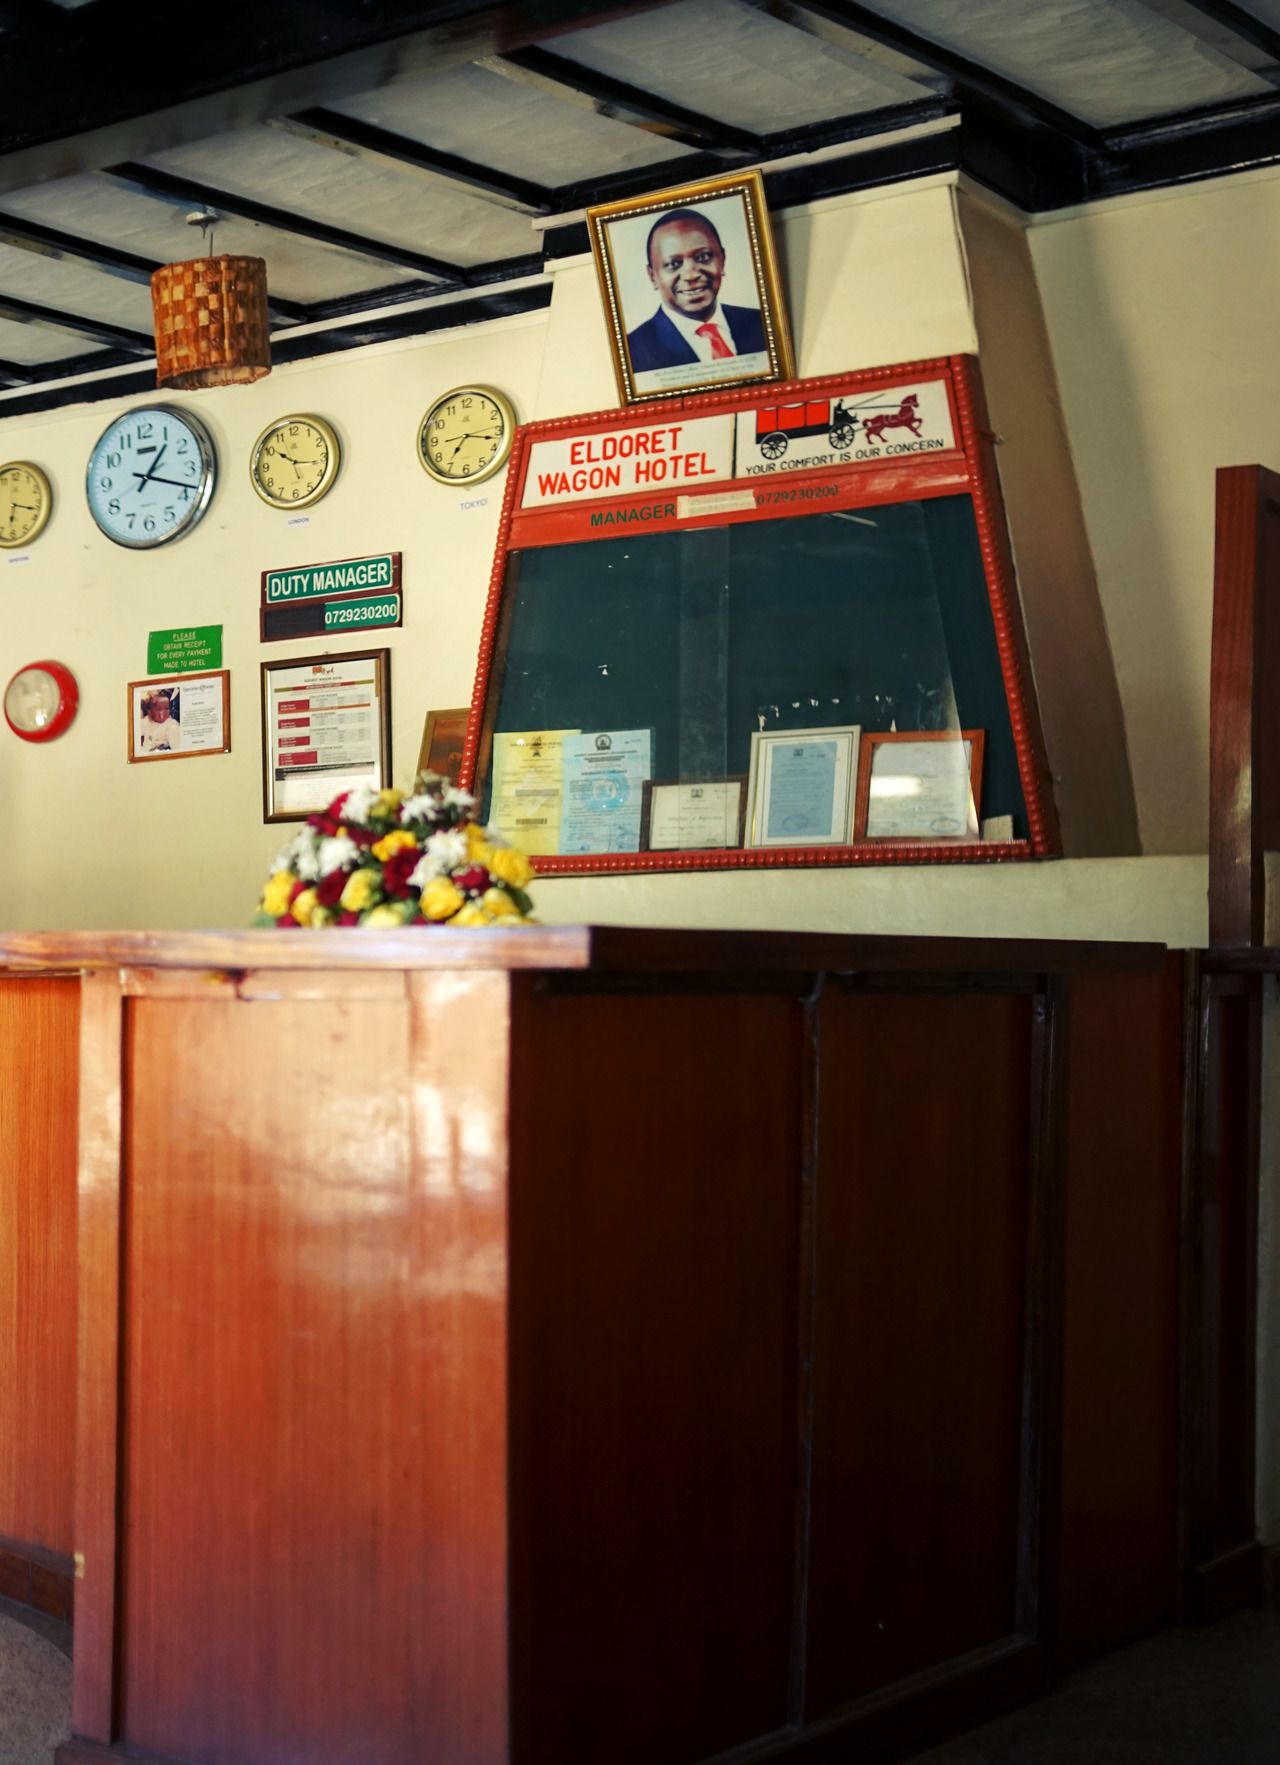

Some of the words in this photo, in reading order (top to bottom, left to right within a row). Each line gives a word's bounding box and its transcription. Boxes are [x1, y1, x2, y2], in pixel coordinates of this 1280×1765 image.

[461, 397, 473, 408] 12
[481, 400, 485, 410] 1
[446, 406, 456, 416] 11
[490, 409, 498, 420] 2
[435, 419, 445, 430] 10
[137, 423, 153, 440] 12
[163, 426, 168, 441] 1
[289, 426, 299, 437] 12
[307, 428, 311, 437] 1
[494, 425, 503, 436] 3
[120, 434, 131, 450] 11
[276, 433, 284, 443] 11
[316, 437, 323, 448] 2
[431, 437, 438, 447] 9
[176, 438, 187, 454] 2
[264, 446, 275, 457] 10
[490, 443, 497, 452] 4
[570, 427, 682, 465] ELDORET
[106, 452, 121, 469] 10
[435, 452, 443, 463] 8
[479, 457, 487, 468] 5
[746, 463, 776, 476] YOUR
[780, 454, 835, 471] COMFORT
[839, 452, 851, 462] IS
[855, 447, 881, 460] OUR
[885, 438, 944, 455] CONCERN
[184, 460, 196, 477] 3
[263, 463, 270, 472] 9
[317, 469, 323, 477] 4
[447, 462, 454, 473] 7
[462, 464, 470, 475] 6
[538, 465, 621, 496] WAGON
[635, 452, 716, 484] HOTEL
[101, 477, 112, 493] 9
[267, 478, 274, 488] 8
[307, 482, 314, 493] 5
[177, 487, 189, 501] 4
[278, 487, 284, 496] 7
[292, 489, 300, 499] 6
[108, 498, 120, 515] 8
[460, 498, 487, 510] TOKYO
[591, 503, 675, 527] MANAGER
[756, 485, 839, 505] 0729230200
[164, 506, 175, 522] 5
[125, 513, 136, 529] 7
[143, 515, 156, 531] 6
[271, 574, 310, 597] DUTY
[313, 562, 388, 591] MANAGER
[324, 604, 397, 624] 0729230200
[172, 631, 196, 641] PLEASE
[184, 640, 206, 648] RECEIPT
[157, 652, 168, 660] FOR
[169, 650, 185, 659] EVERY
[187, 648, 211, 656] PAYMENT
[164, 661, 179, 669] MADE
